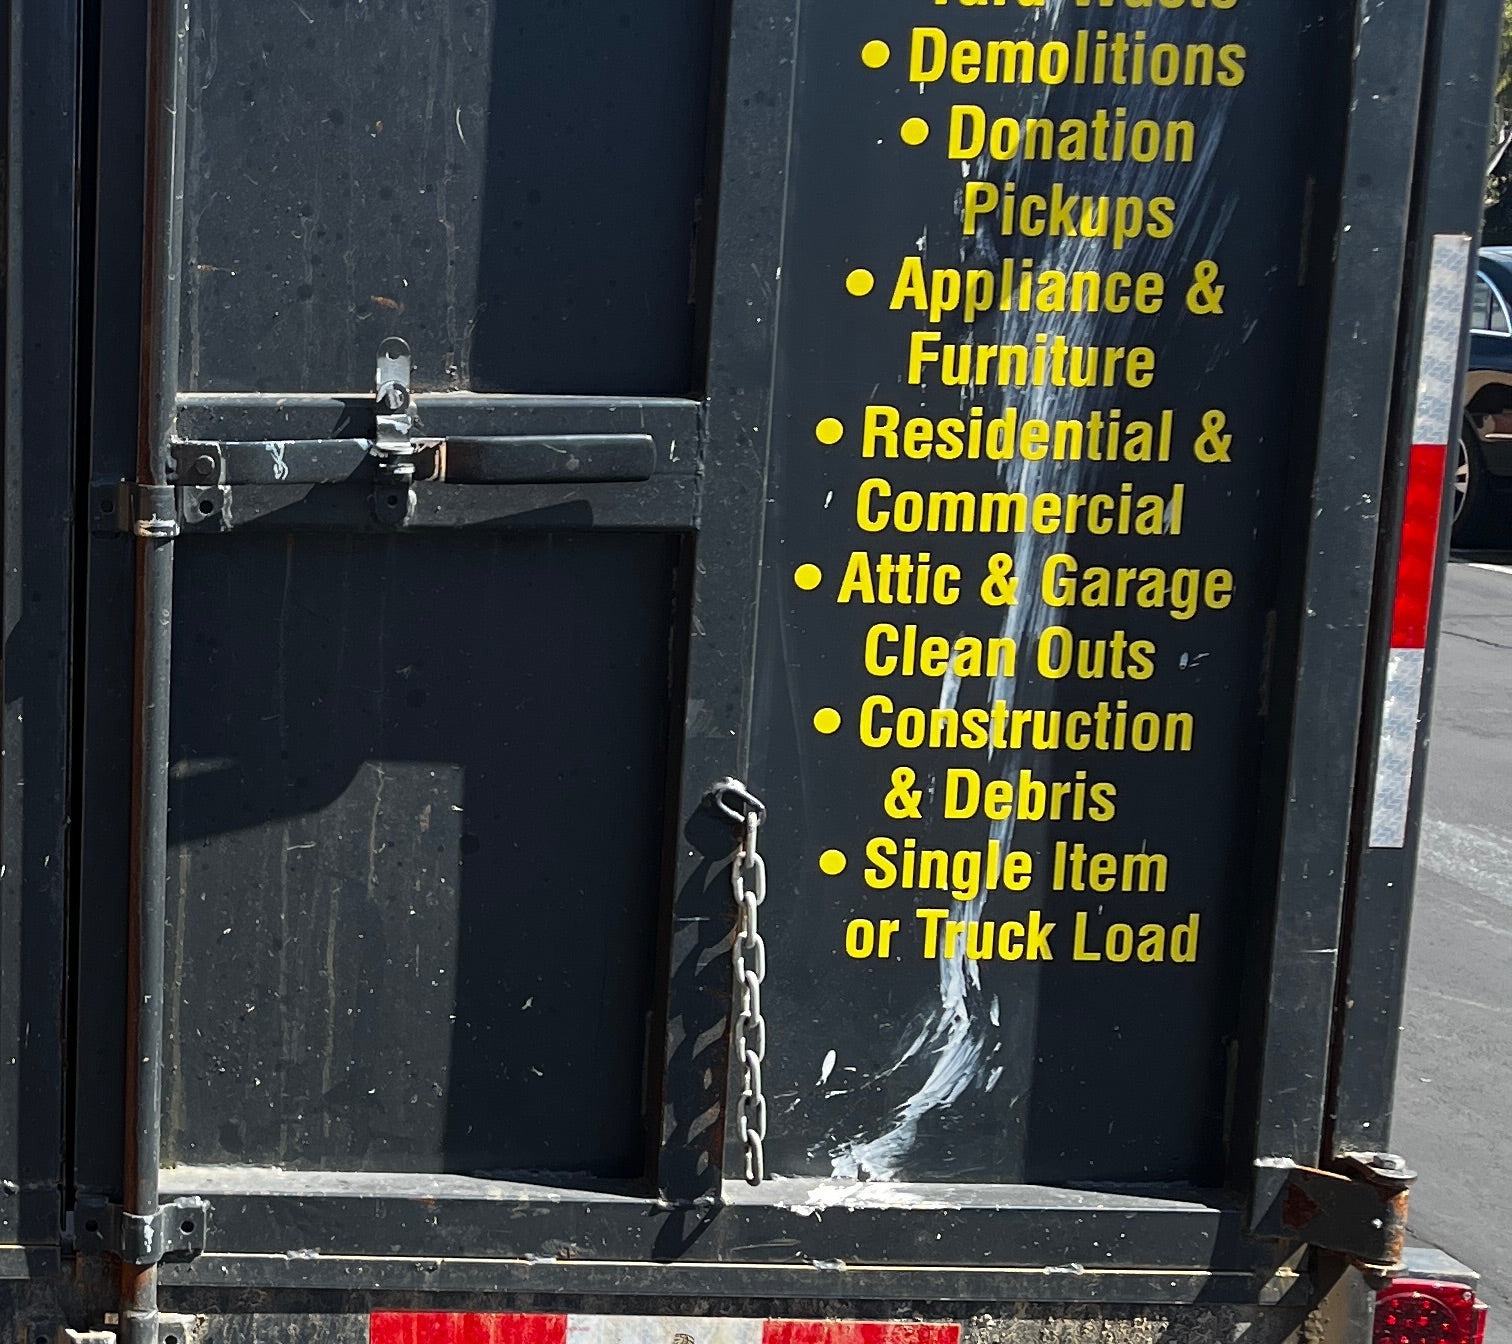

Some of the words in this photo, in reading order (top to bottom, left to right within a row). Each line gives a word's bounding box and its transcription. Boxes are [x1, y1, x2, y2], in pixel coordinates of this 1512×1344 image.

[908, 27, 1247, 87] Demolitions
[947, 104, 1195, 163] Donation
[962, 181, 1176, 249] Pickups
[889, 256, 1165, 324] Appliance
[1185, 260, 1225, 315] &
[907, 331, 1156, 389] Furniture
[861, 405, 1174, 462] Residential
[1193, 410, 1233, 464] &
[856, 478, 1185, 536] Commercial
[837, 552, 962, 606] Attic
[980, 552, 1018, 607] &
[1040, 553, 1234, 620] Garage
[864, 623, 1017, 679] Clean
[1036, 626, 1156, 681] Outs
[858, 695, 1194, 752] Construction
[883, 766, 923, 820] &
[944, 768, 1118, 822] Debris
[863, 837, 1033, 903] Single
[1052, 841, 1168, 893] Item
[845, 919, 900, 960] or
[914, 908, 1056, 962] Truck
[1072, 912, 1201, 964] Load
